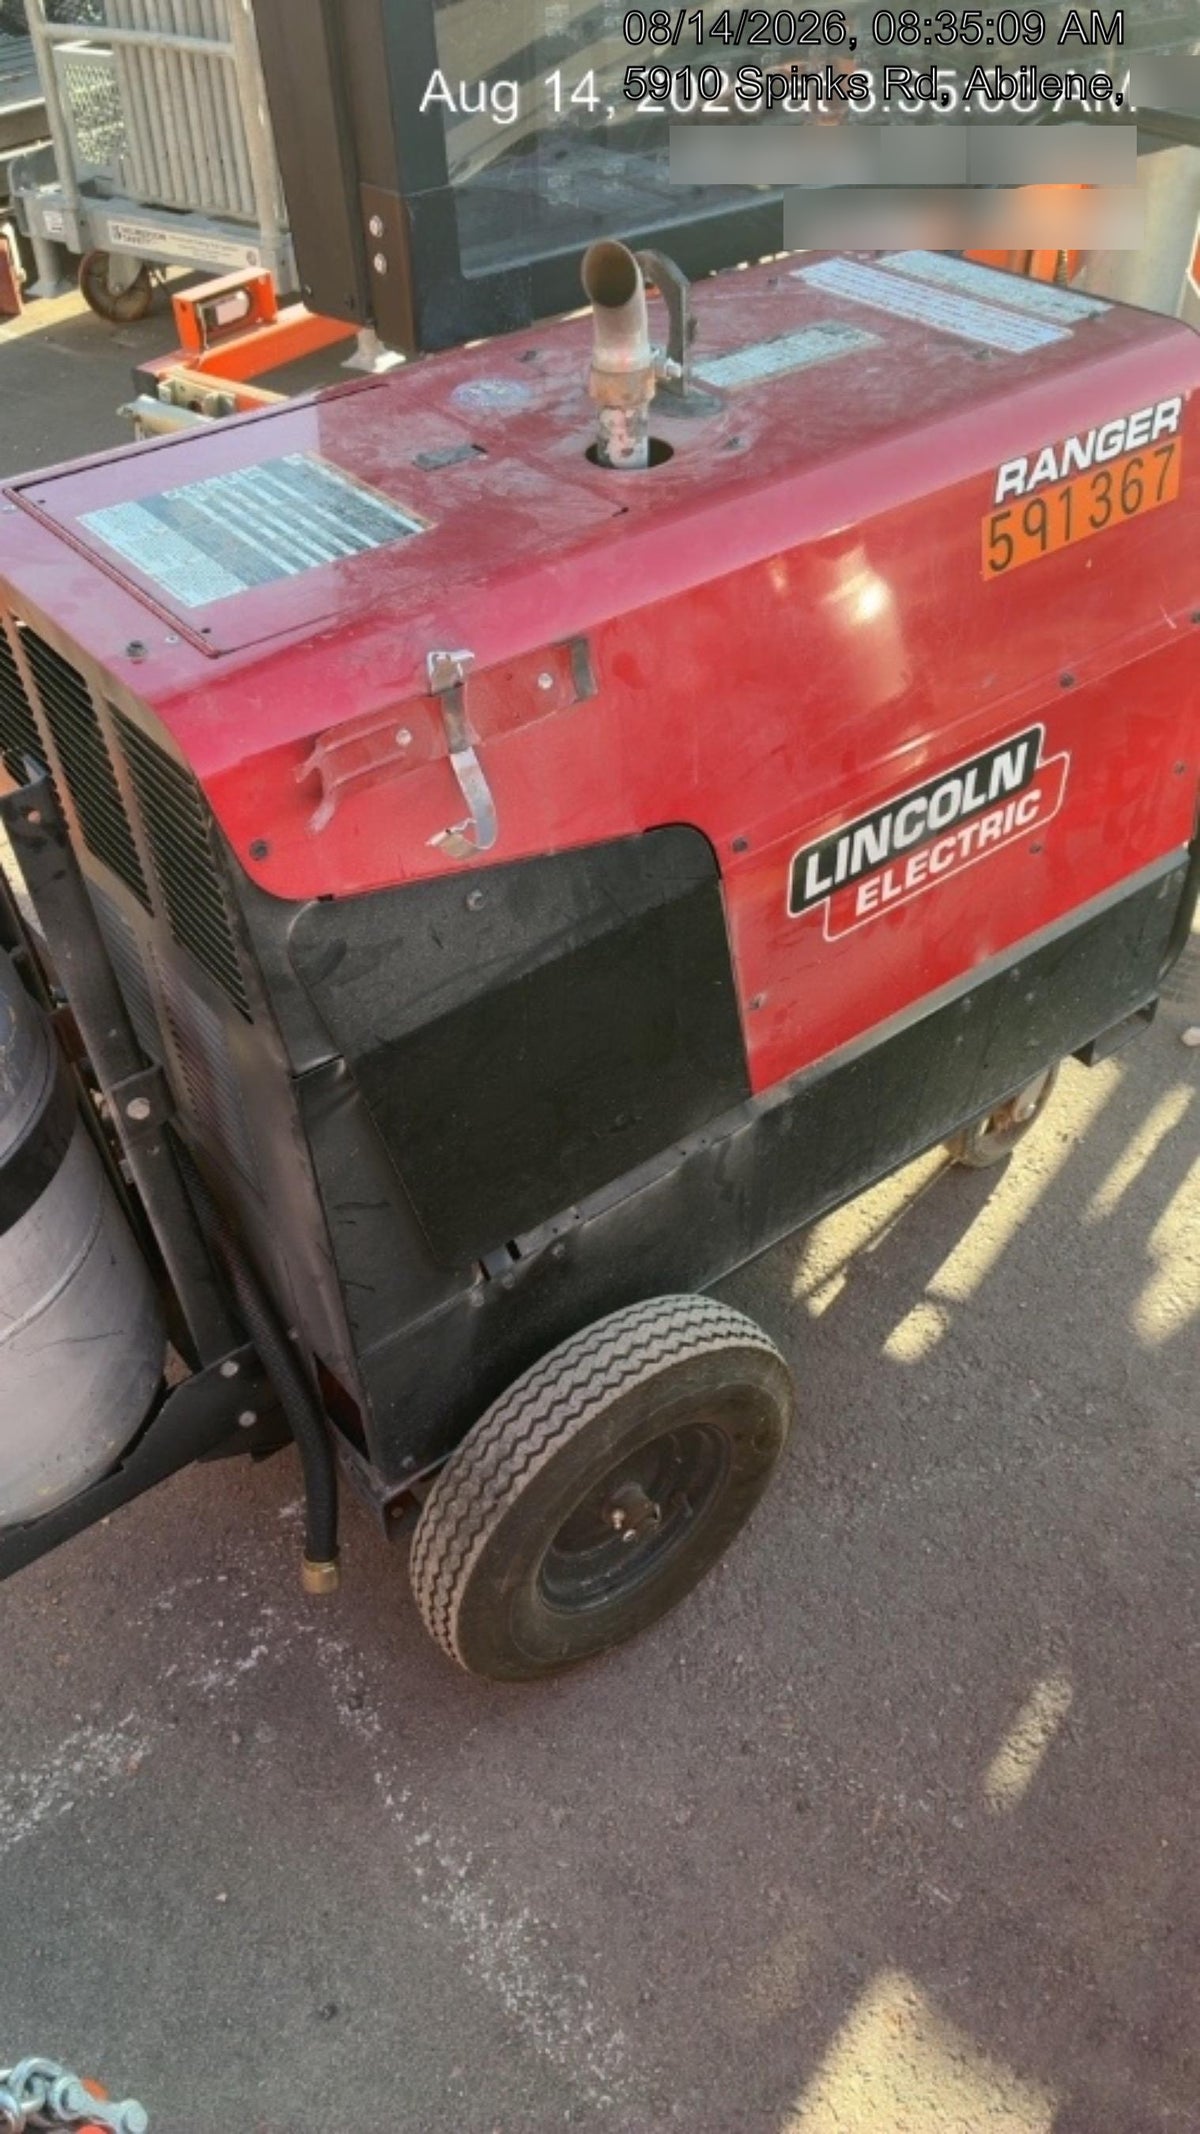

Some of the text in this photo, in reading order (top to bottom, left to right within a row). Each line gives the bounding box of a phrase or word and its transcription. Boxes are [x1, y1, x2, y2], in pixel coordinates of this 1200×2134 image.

[988, 443, 1176, 572] 591367
[994, 396, 1182, 505] RANGER
[804, 741, 1029, 900] LINCOLN
[855, 789, 1042, 917] ELECTRIC
